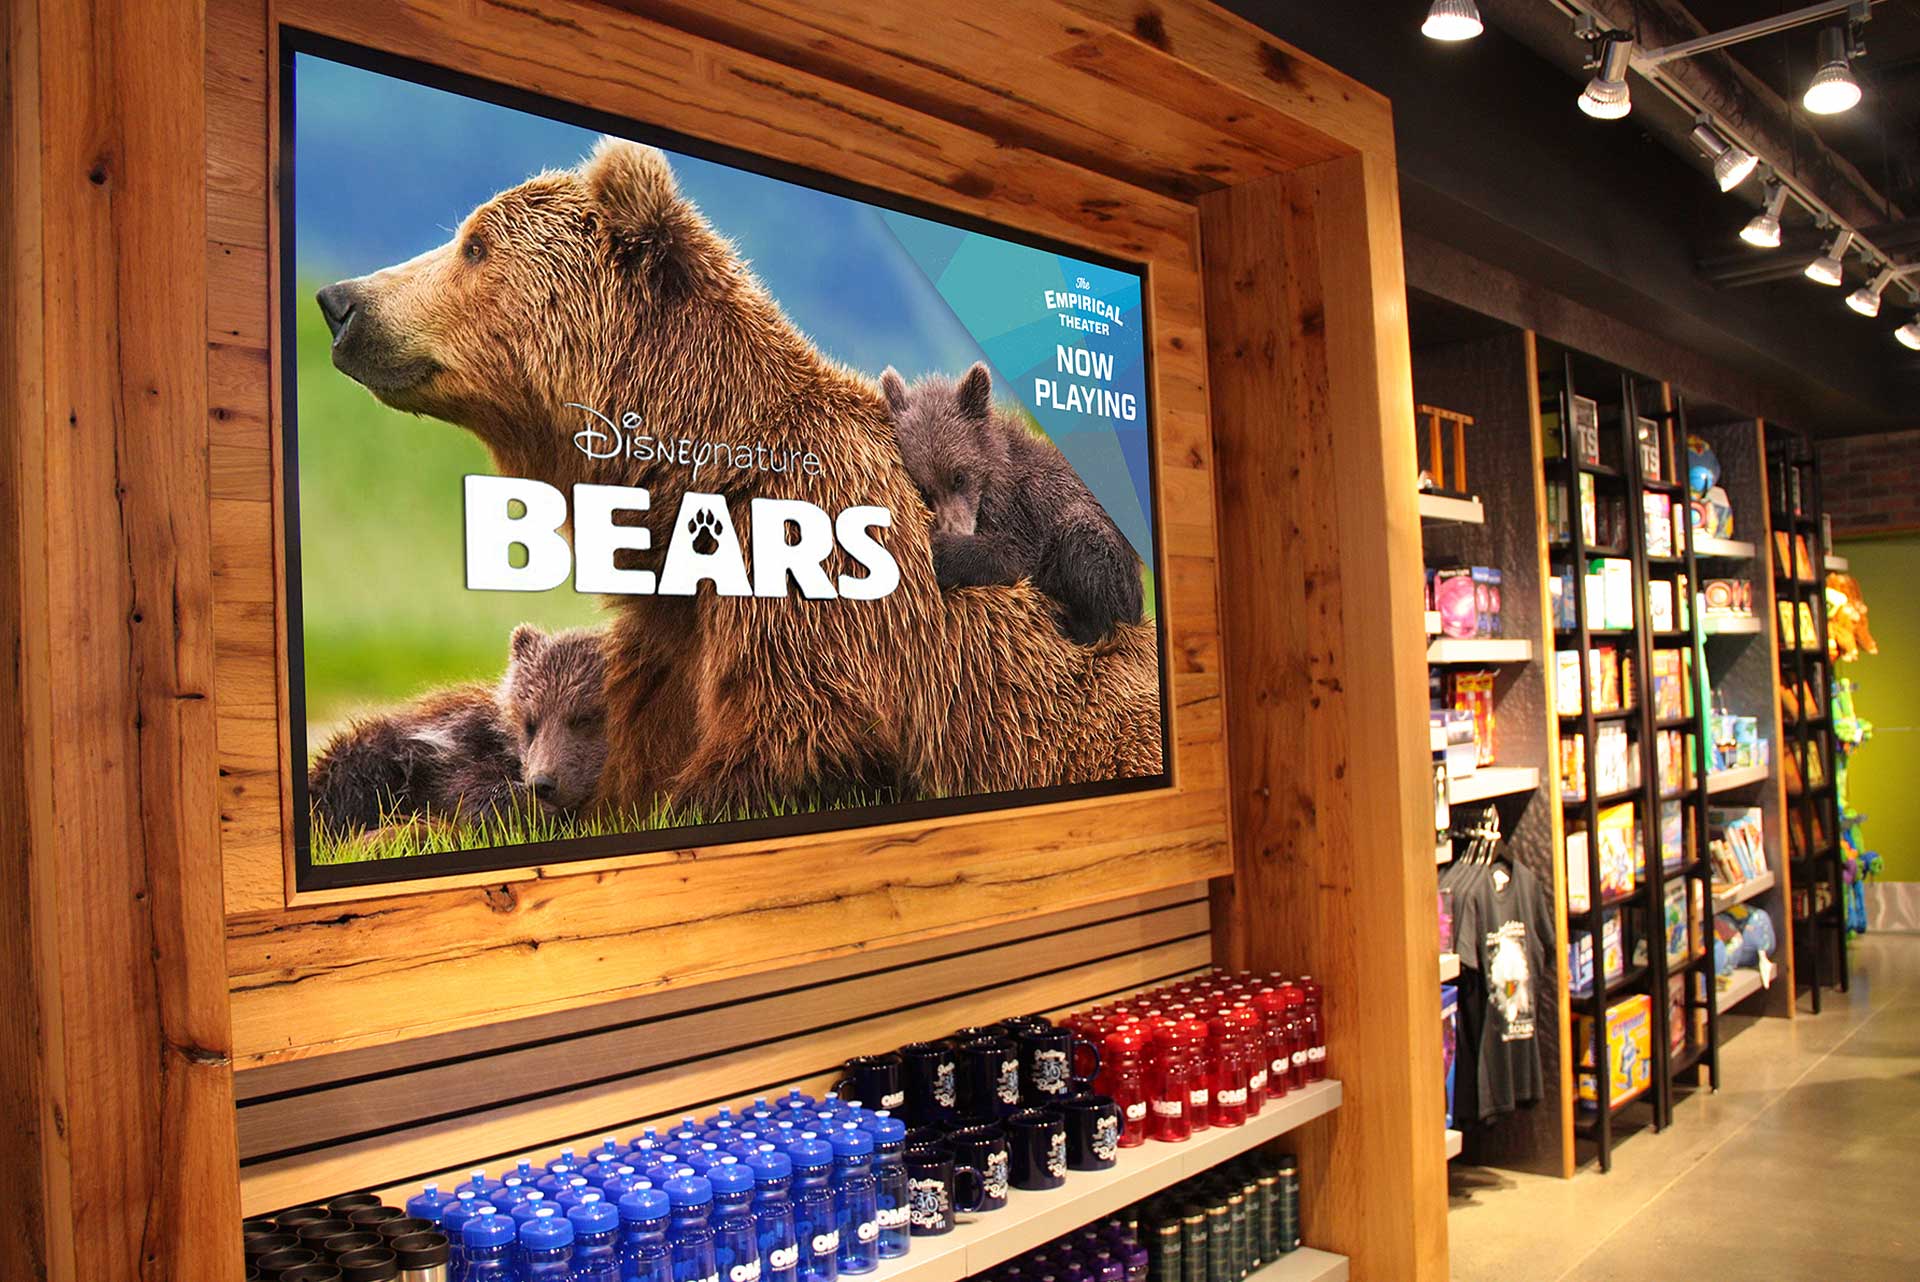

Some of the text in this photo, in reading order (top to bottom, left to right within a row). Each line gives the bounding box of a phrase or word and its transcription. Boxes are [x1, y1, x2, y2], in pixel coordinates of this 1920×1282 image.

[1075, 276, 1091, 291] The
[1044, 289, 1124, 327] EMPIRICAL
[1058, 313, 1110, 337] THEATER
[1056, 343, 1114, 382] NOW
[1034, 377, 1137, 422] PLAYING
[464, 474, 901, 601] BEARS
